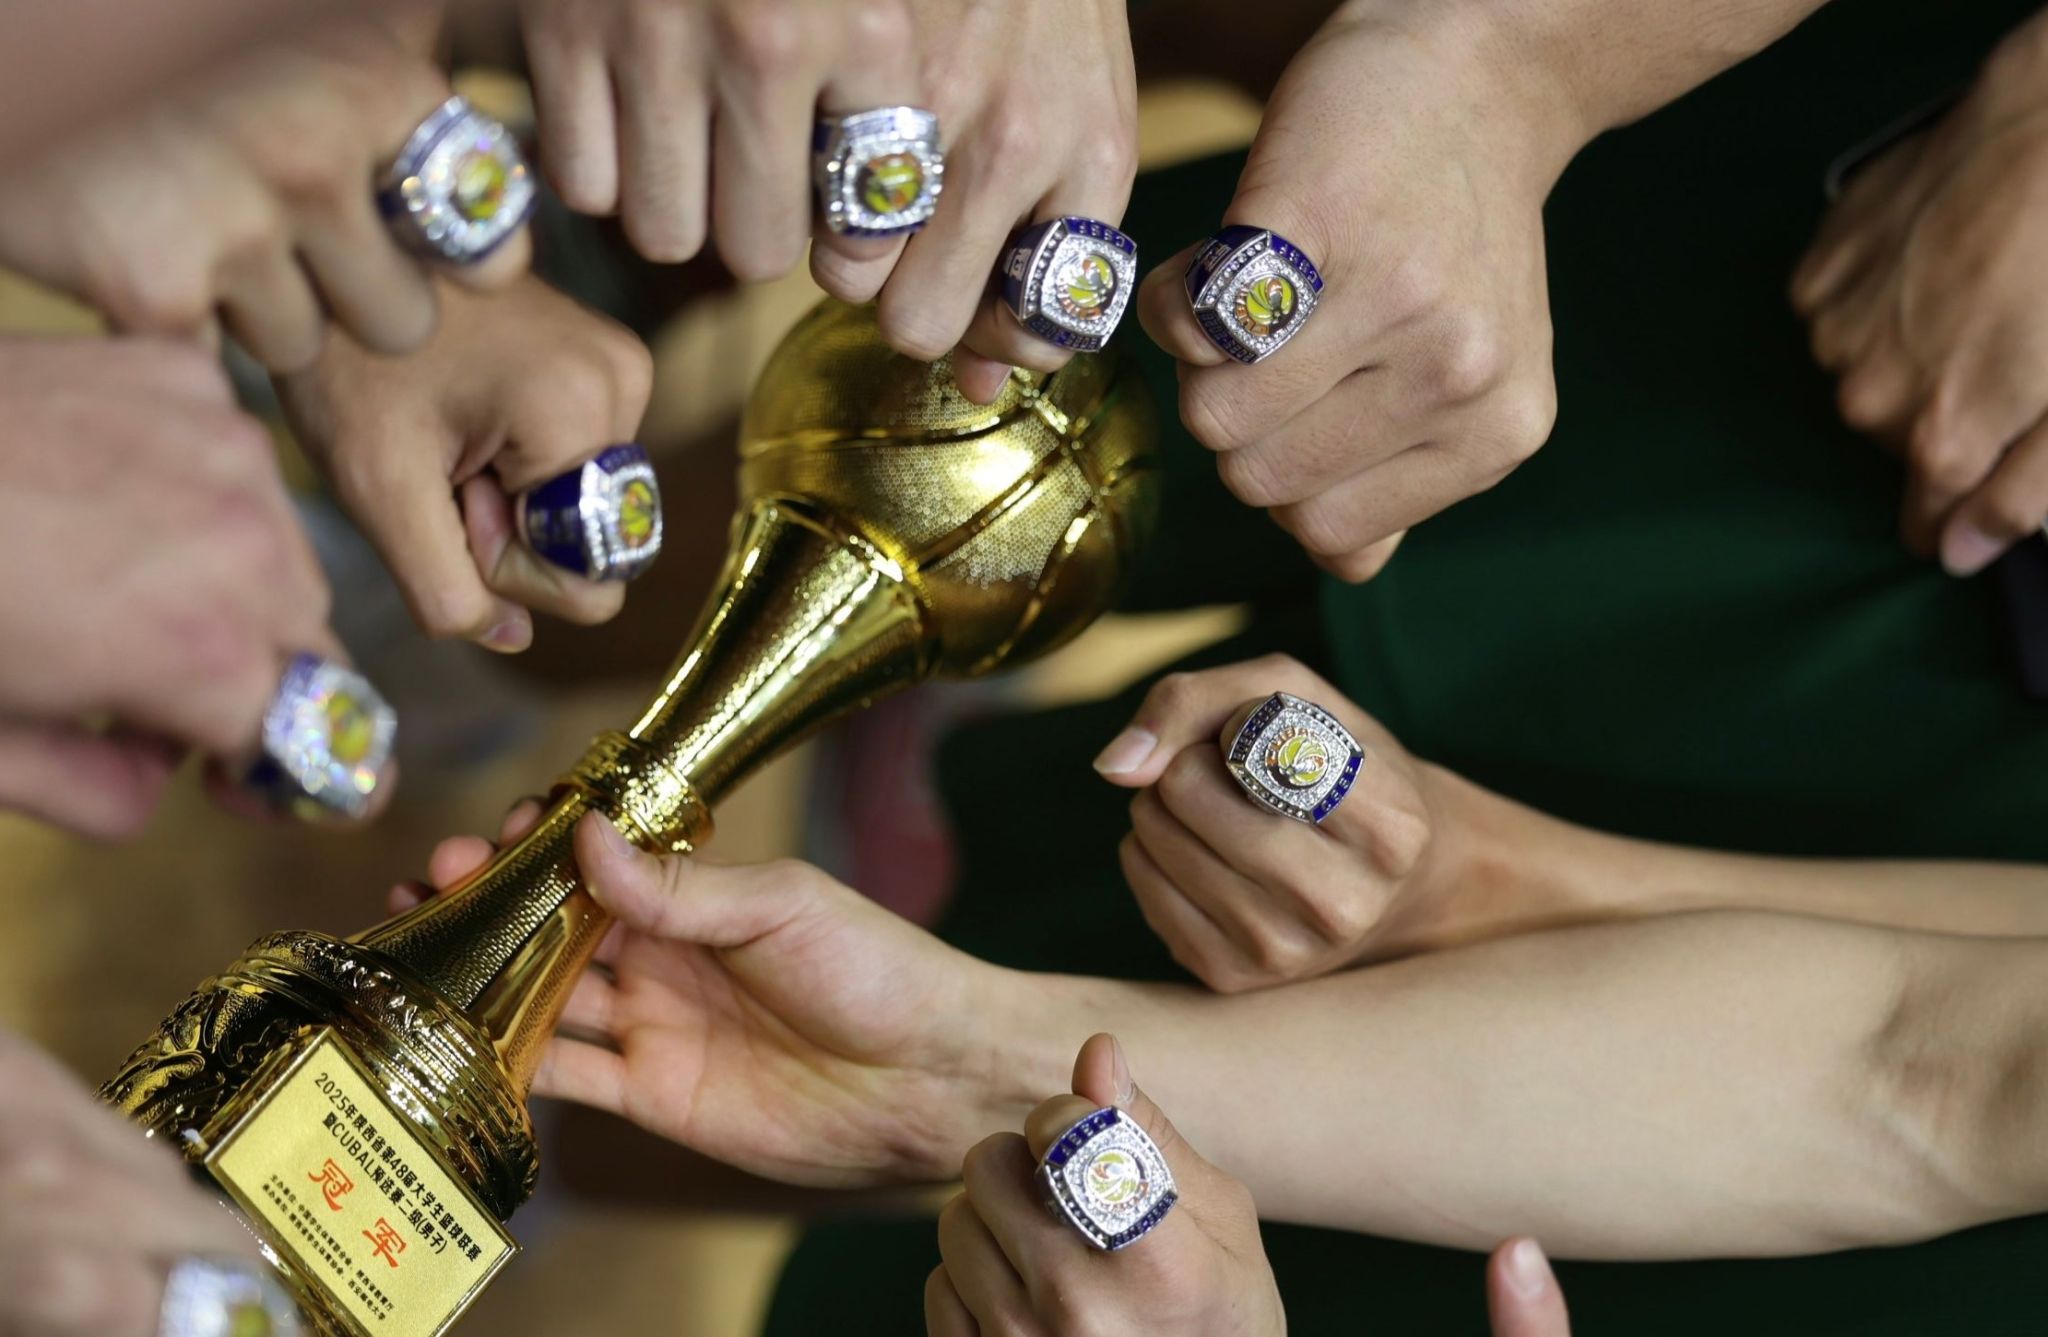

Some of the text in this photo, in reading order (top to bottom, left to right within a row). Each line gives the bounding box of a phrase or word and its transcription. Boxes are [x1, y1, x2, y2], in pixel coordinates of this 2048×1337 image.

[314, 1072, 482, 1262] 2025年陕西省第48届大学生篮球联赛
